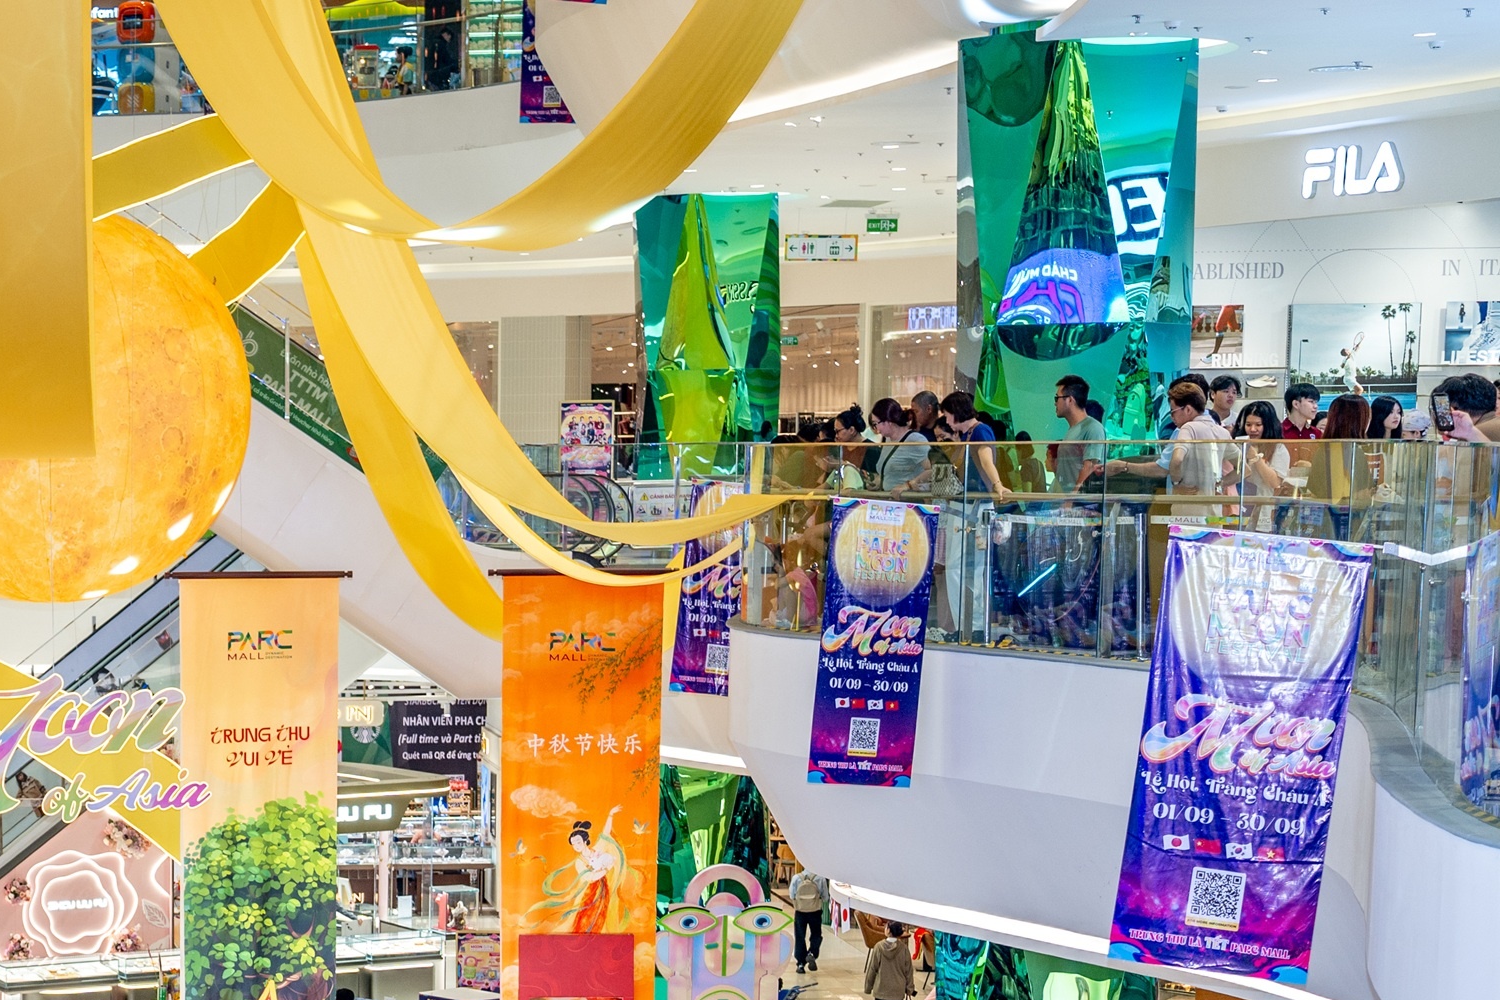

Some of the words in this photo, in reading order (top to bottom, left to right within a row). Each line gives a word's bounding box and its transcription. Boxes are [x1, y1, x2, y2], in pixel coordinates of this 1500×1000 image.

[1302, 141, 1404, 199] FILA
[1442, 259, 1461, 276] IN
[1211, 353, 1279, 368] RUNNING
[289, 370, 328, 404] TTTM
[869, 504, 902, 517] PARC
[856, 536, 909, 556] PARC
[854, 553, 908, 573] MOON
[853, 571, 906, 583] FESTIVAL
[228, 630, 293, 651] PARC
[821, 605, 922, 656] Moon
[1206, 613, 1312, 648] MOON
[549, 632, 616, 652] PARC
[873, 637, 890, 656] of
[889, 637, 922, 655] Asia
[227, 652, 264, 661] MALL
[549, 653, 587, 661] MALL
[829, 677, 862, 689] 01/09
[872, 679, 909, 693] 30/09
[346, 705, 375, 725] PNJ
[402, 716, 430, 727] NHÂN
[431, 714, 453, 727] VIÊN
[454, 715, 474, 726] PHA
[475, 715, 487, 725] CH
[211, 727, 271, 744] TRUNG
[276, 724, 310, 742] THU
[398, 733, 417, 746] (Full
[418, 734, 439, 744] time
[440, 733, 452, 744] và
[453, 733, 473, 744] Part
[1140, 693, 1336, 773] Moon
[527, 733, 643, 757] 中秋节快乐
[226, 750, 259, 767] VUI
[402, 750, 420, 760] Quét
[420, 752, 433, 760] mã
[434, 752, 446, 760] QR
[446, 750, 457, 760] để
[457, 751, 472, 762] ứng
[1238, 747, 1272, 776] of
[1267, 750, 1336, 779] Asia
[40, 773, 91, 824] of
[86, 767, 212, 812] Asia
[1141, 770, 1167, 794] Lễ
[1166, 774, 1199, 793] Hội
[1205, 776, 1259, 805] Trăng
[1263, 784, 1309, 806] Châu
[363, 804, 392, 820] FU
[1152, 802, 1215, 825] 01/09
[1236, 812, 1305, 836] 30/09
[1128, 928, 1164, 942] TRUNG
[1165, 932, 1188, 946] THU
[1188, 933, 1203, 948] LÀ
[1203, 934, 1230, 951] TẾT
[1229, 942, 1259, 956] PARC
[1260, 947, 1291, 960] MALL
